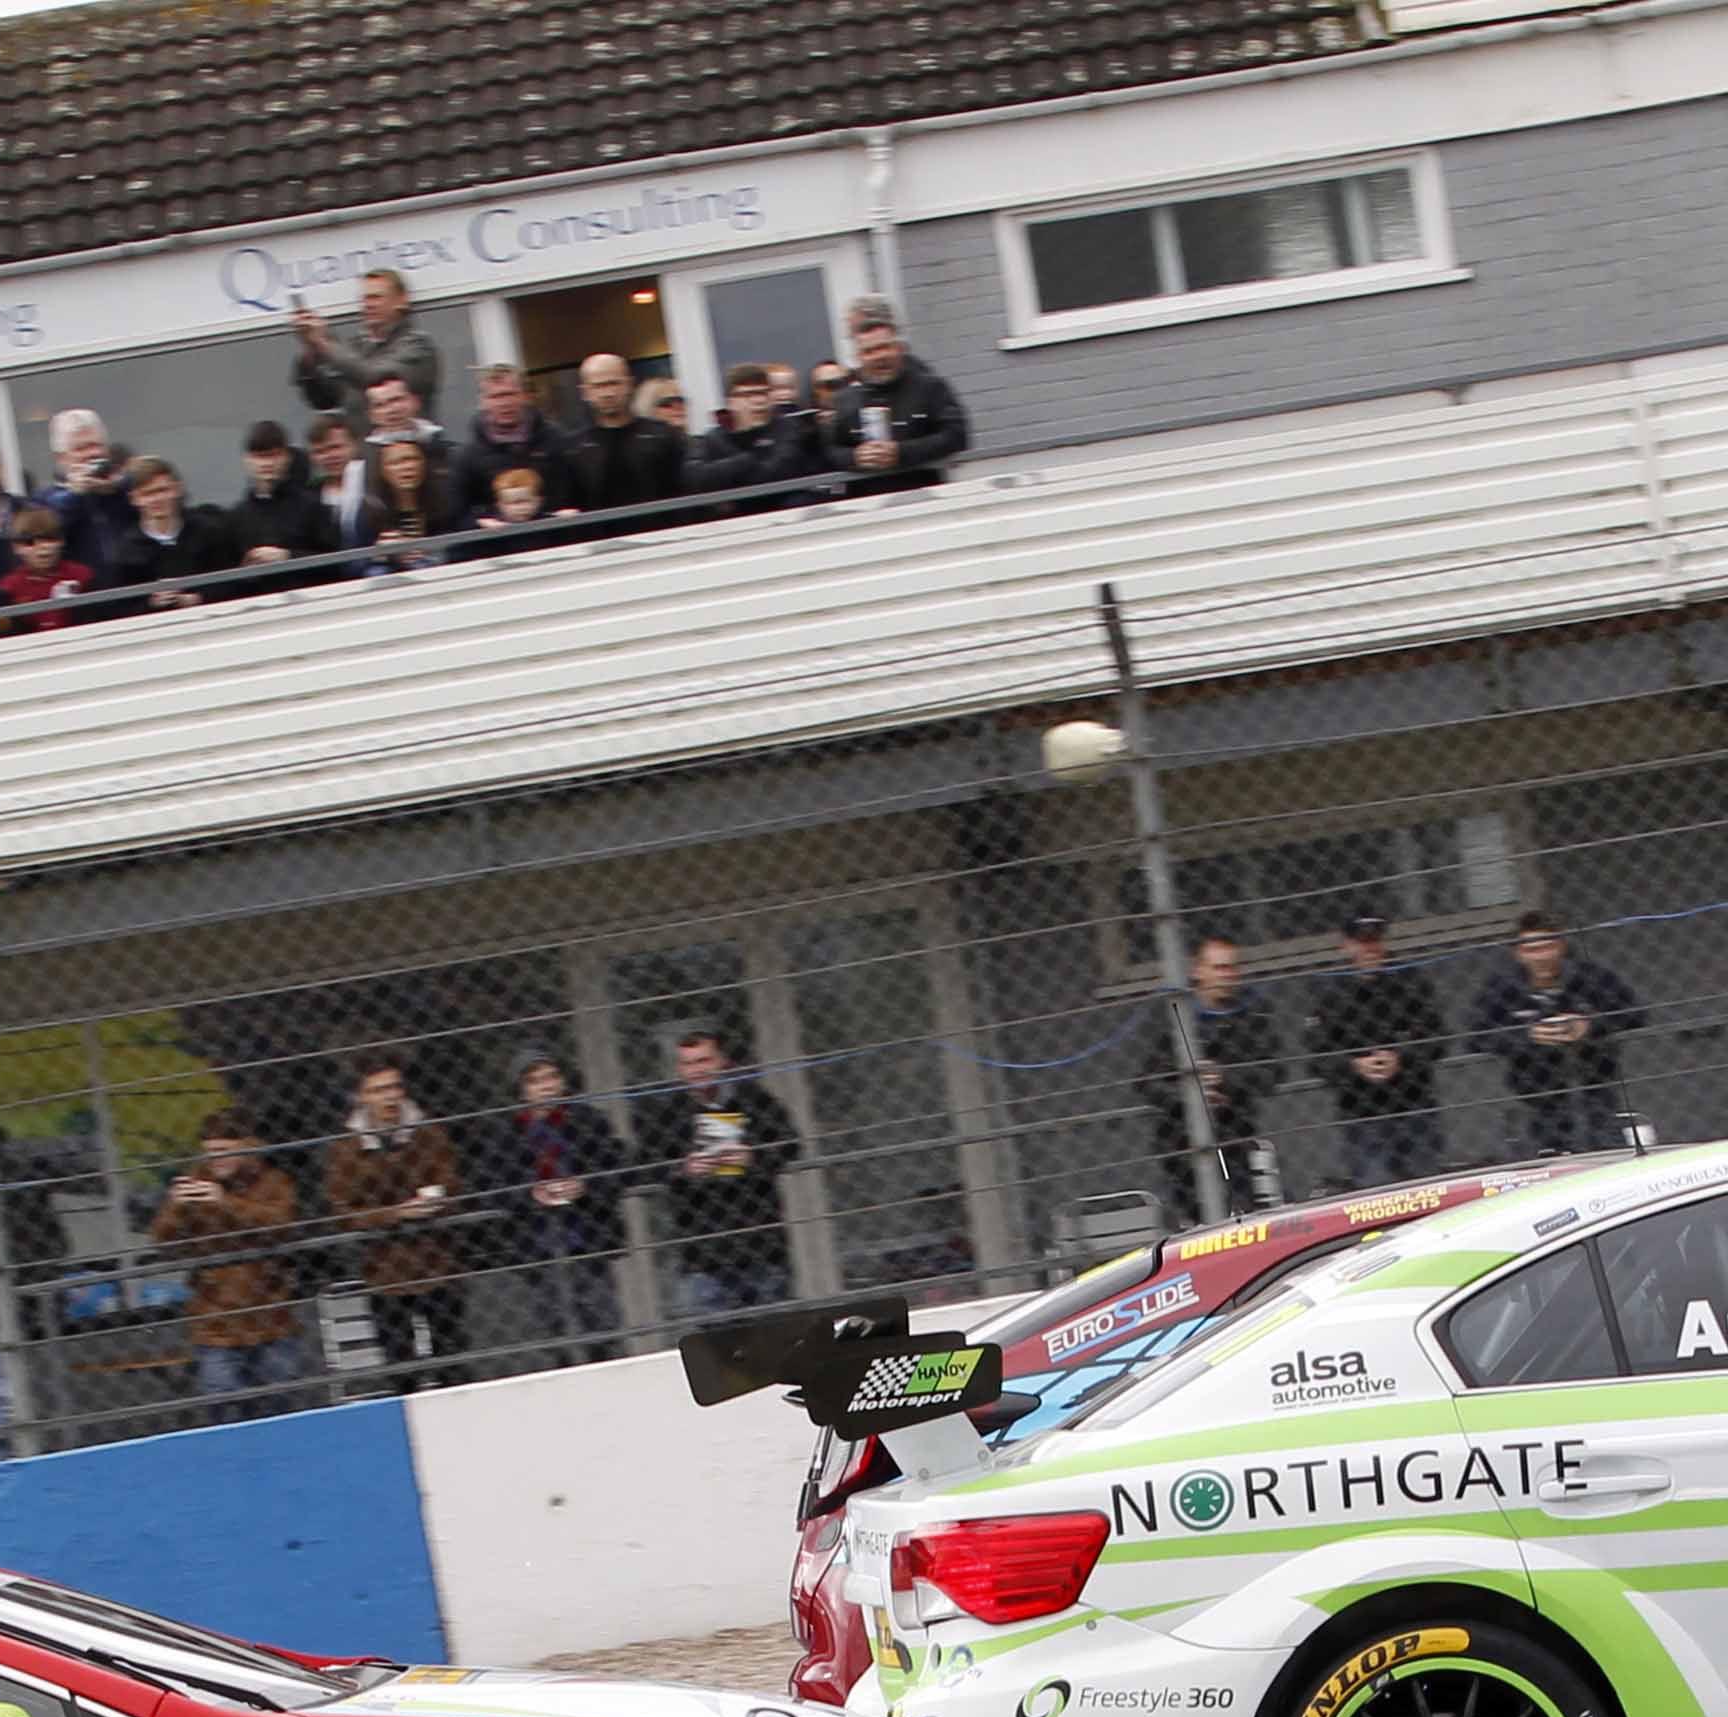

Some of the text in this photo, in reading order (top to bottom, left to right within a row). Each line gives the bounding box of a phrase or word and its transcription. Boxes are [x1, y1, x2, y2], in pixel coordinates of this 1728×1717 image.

[219, 184, 766, 313] Quantex Consulting
[1343, 1185, 1449, 1215] WORKPLACE
[1349, 1196, 1441, 1225] PRODUCTS
[1181, 1223, 1270, 1260] DIRECT
[917, 1363, 968, 1380] HANDY
[1270, 1350, 1367, 1387] alsa
[847, 1389, 963, 1412] Motorsport
[1272, 1376, 1396, 1405] automotive
[1110, 1438, 1588, 1537] NORTHGATE
[1078, 1685, 1234, 1713] Freestyle 360
